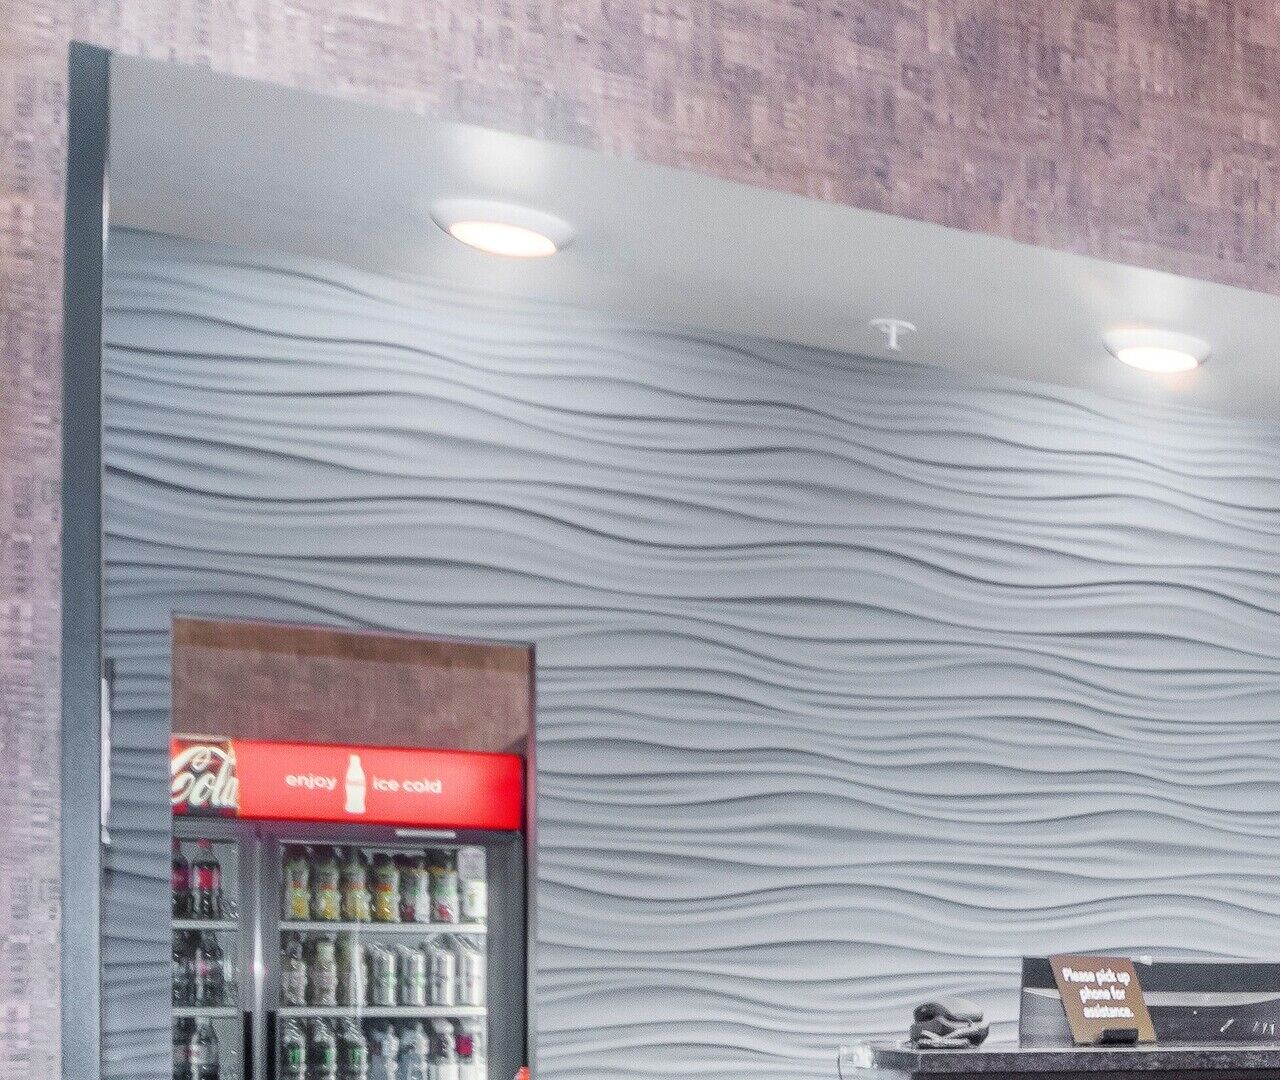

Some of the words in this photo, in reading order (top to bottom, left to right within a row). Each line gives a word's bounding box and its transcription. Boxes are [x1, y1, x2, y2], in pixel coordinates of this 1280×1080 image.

[284, 773, 337, 791] enjoy
[372, 776, 399, 792] ice
[402, 778, 442, 794] cold
[1062, 967, 1096, 982] Please
[1095, 967, 1117, 986] pick
[1116, 971, 1131, 986] up
[1079, 984, 1112, 1004] phone
[1110, 985, 1126, 1000] for
[1083, 1003, 1135, 1018] assistance.
